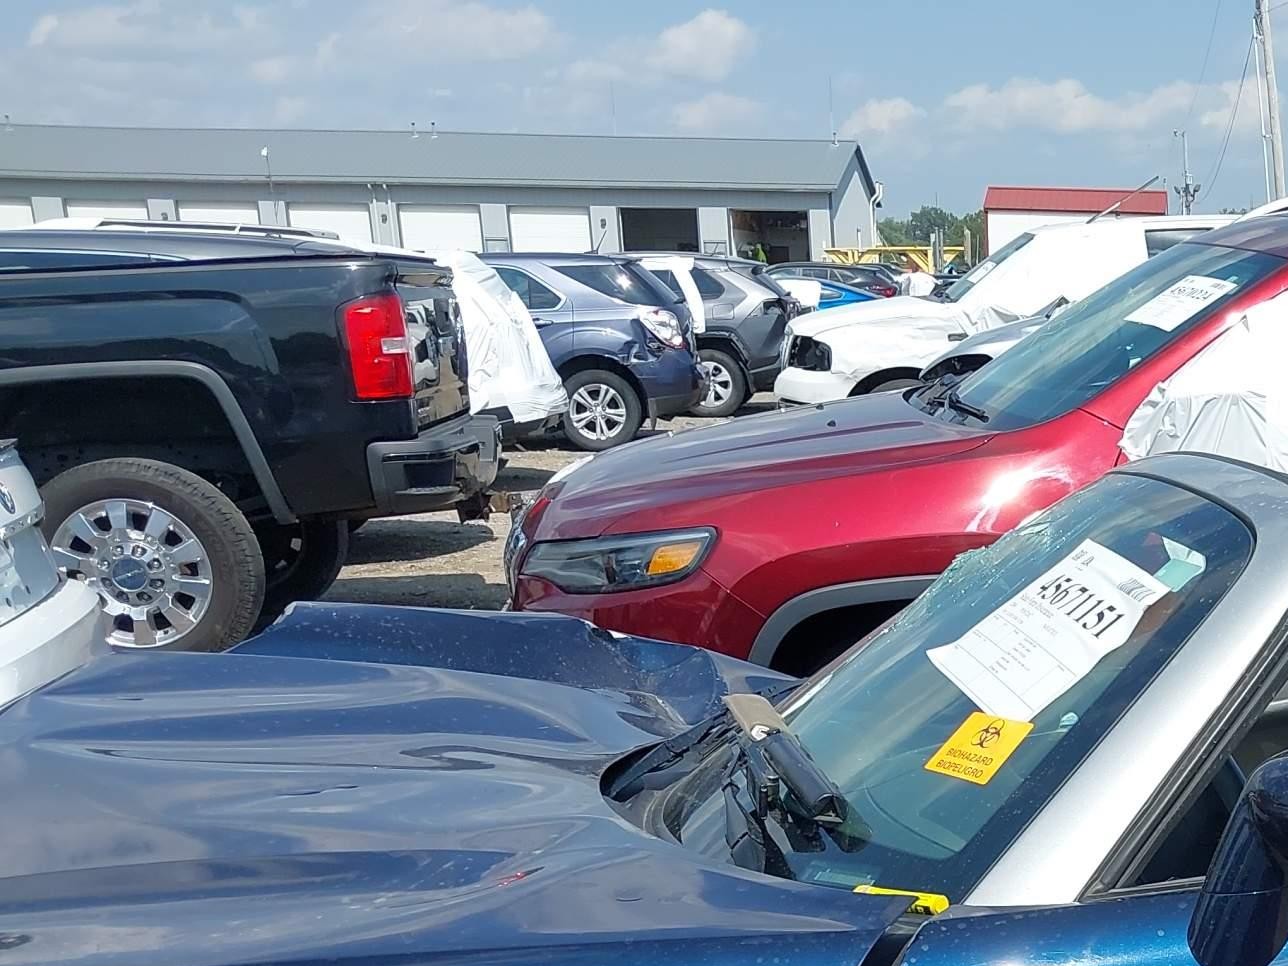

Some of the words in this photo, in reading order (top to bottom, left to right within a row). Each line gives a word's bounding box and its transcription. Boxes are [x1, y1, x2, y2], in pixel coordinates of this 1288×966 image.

[1036, 573, 1125, 639] 45671151
[945, 747, 994, 767] BIOHAZARD
[935, 758, 984, 779] BIOPELIGRO
